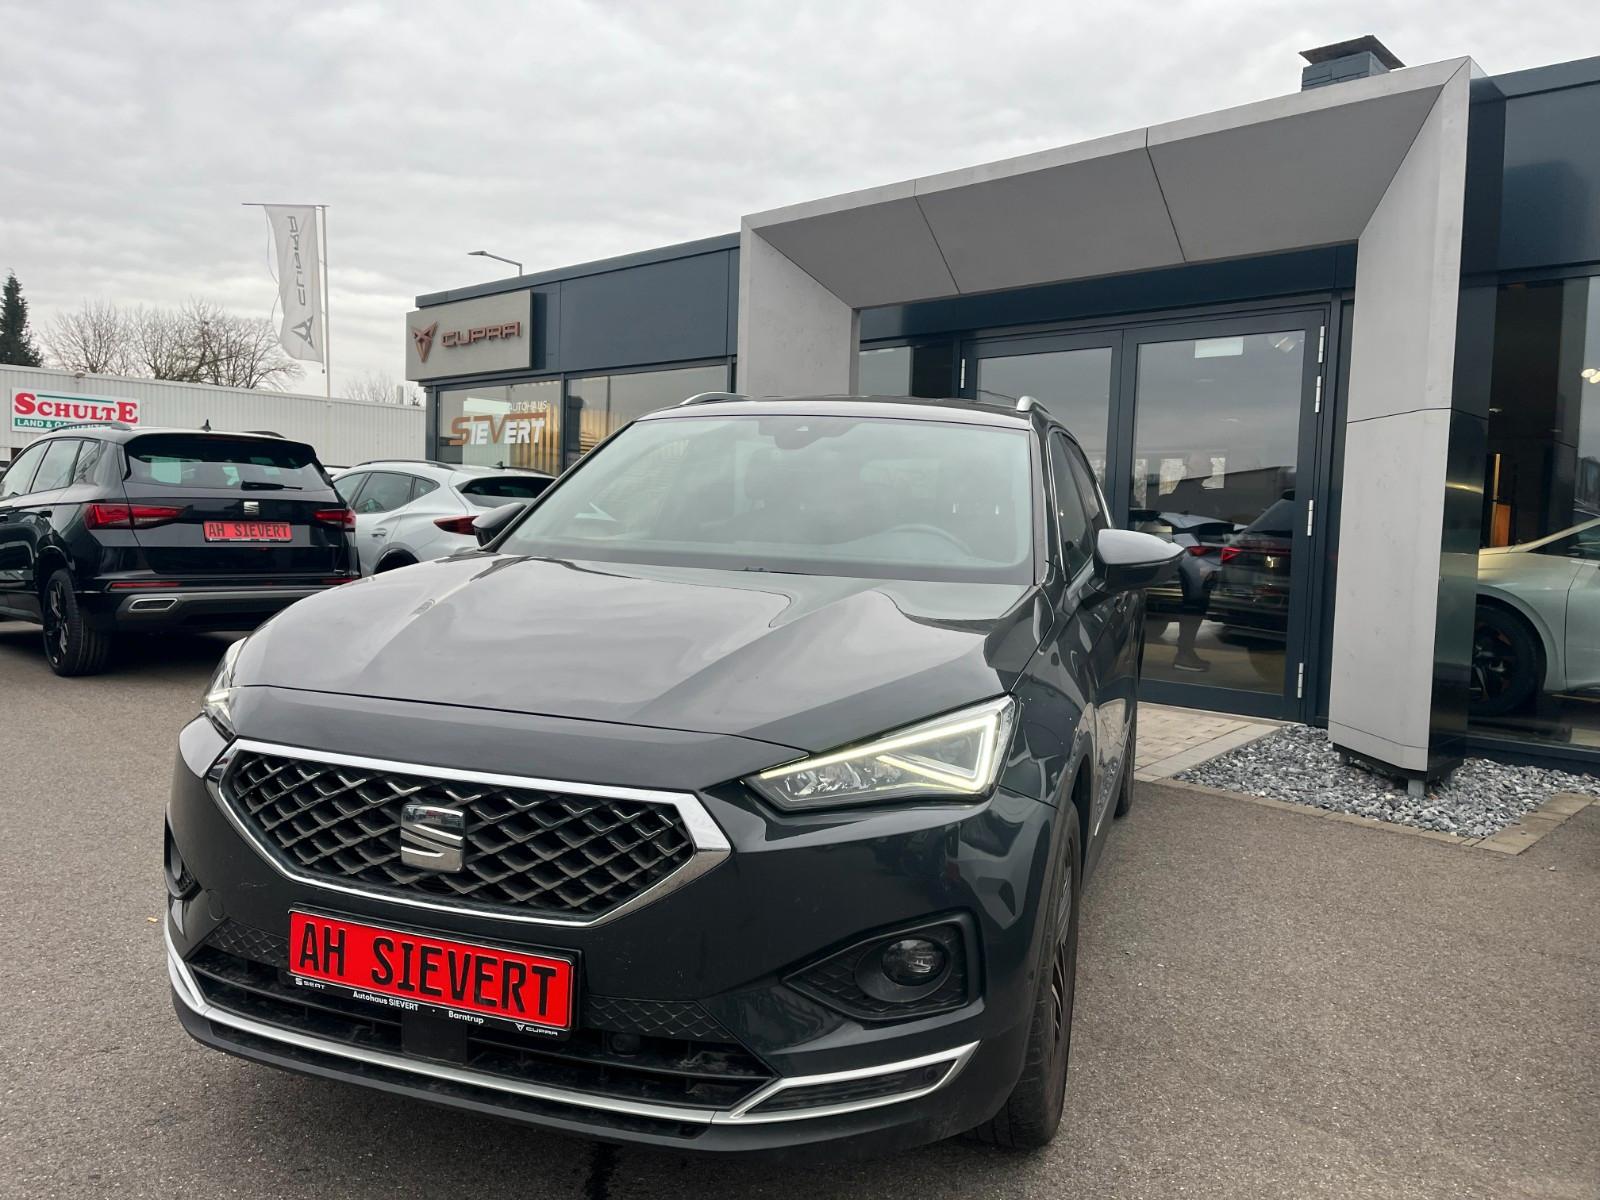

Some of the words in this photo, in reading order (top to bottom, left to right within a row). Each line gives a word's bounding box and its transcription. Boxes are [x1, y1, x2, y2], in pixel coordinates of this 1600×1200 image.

[441, 321, 521, 347] CUPRA
[15, 393, 138, 423] SCHULTE
[509, 401, 547, 411] AUTOHAUS
[17, 418, 43, 428] LAND
[46, 420, 50, 428] &
[448, 412, 547, 446] SIEVERT
[208, 523, 225, 537] AH
[235, 524, 288, 537] SIEVERT
[298, 921, 346, 977] AH
[370, 936, 557, 1017] SIEVERT
[352, 990, 387, 1005] Autohaus
[388, 998, 419, 1011] SIEVERT
[448, 1010, 484, 1025] Barntrup
[525, 1026, 558, 1036] CUPRA
